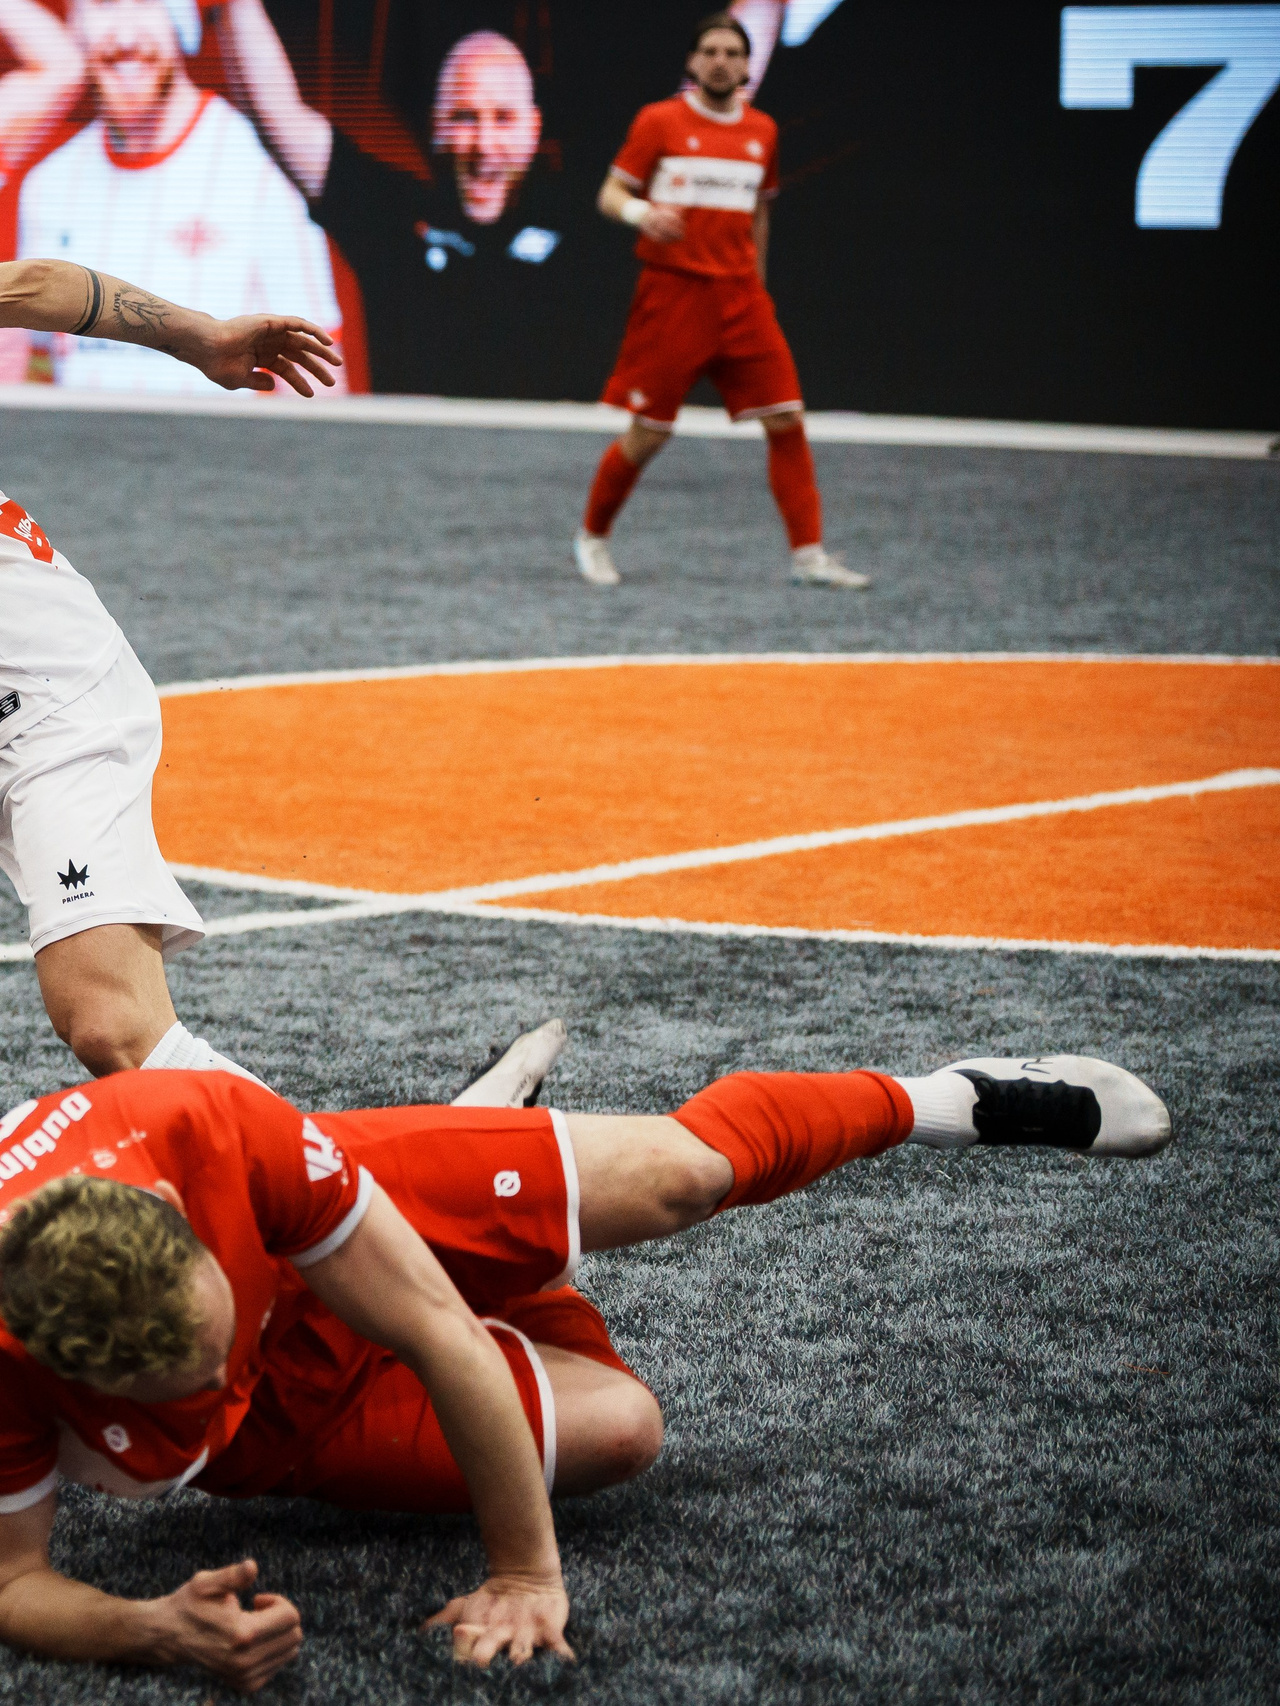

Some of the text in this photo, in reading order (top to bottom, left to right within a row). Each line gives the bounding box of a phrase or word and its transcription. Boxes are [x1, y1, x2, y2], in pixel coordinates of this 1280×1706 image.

[1059, 4, 1280, 230] 7
[113, 292, 122, 313] LOVE
[61, 890, 96, 905] PRIMERA
